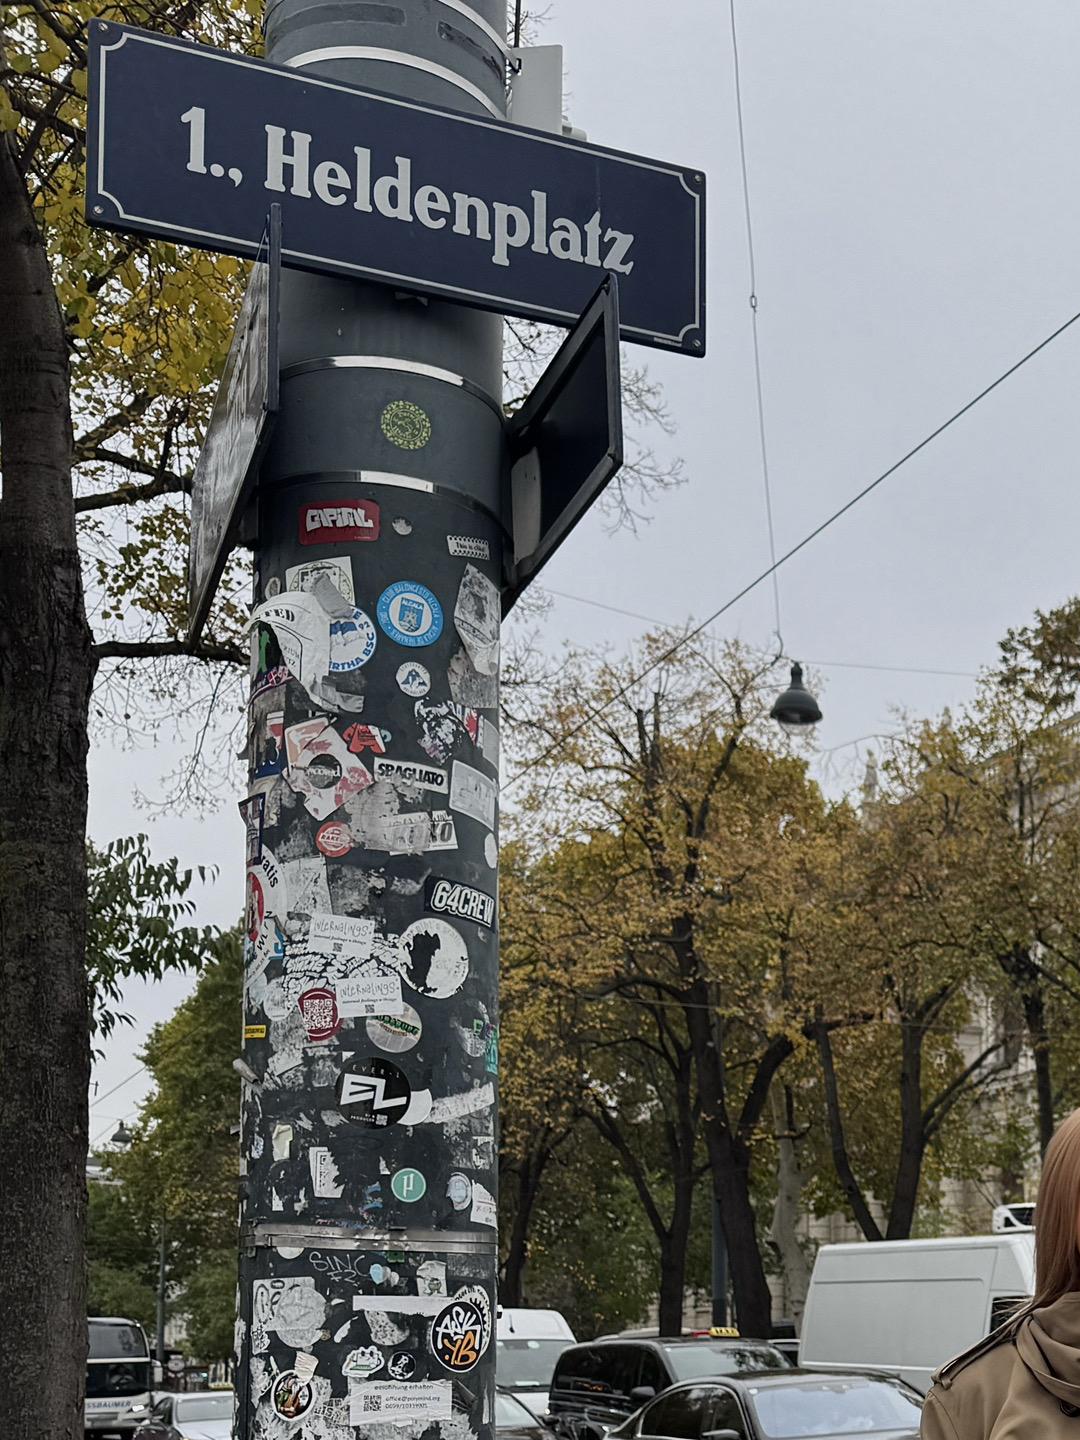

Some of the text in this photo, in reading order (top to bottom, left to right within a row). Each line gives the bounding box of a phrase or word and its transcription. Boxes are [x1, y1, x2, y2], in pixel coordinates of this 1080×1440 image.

[180, 106, 636, 276] 1., Heldenplatz
[362, 631, 375, 656] BSC
[377, 762, 444, 787] SBAGLIATO
[431, 880, 495, 927] 64CREW
